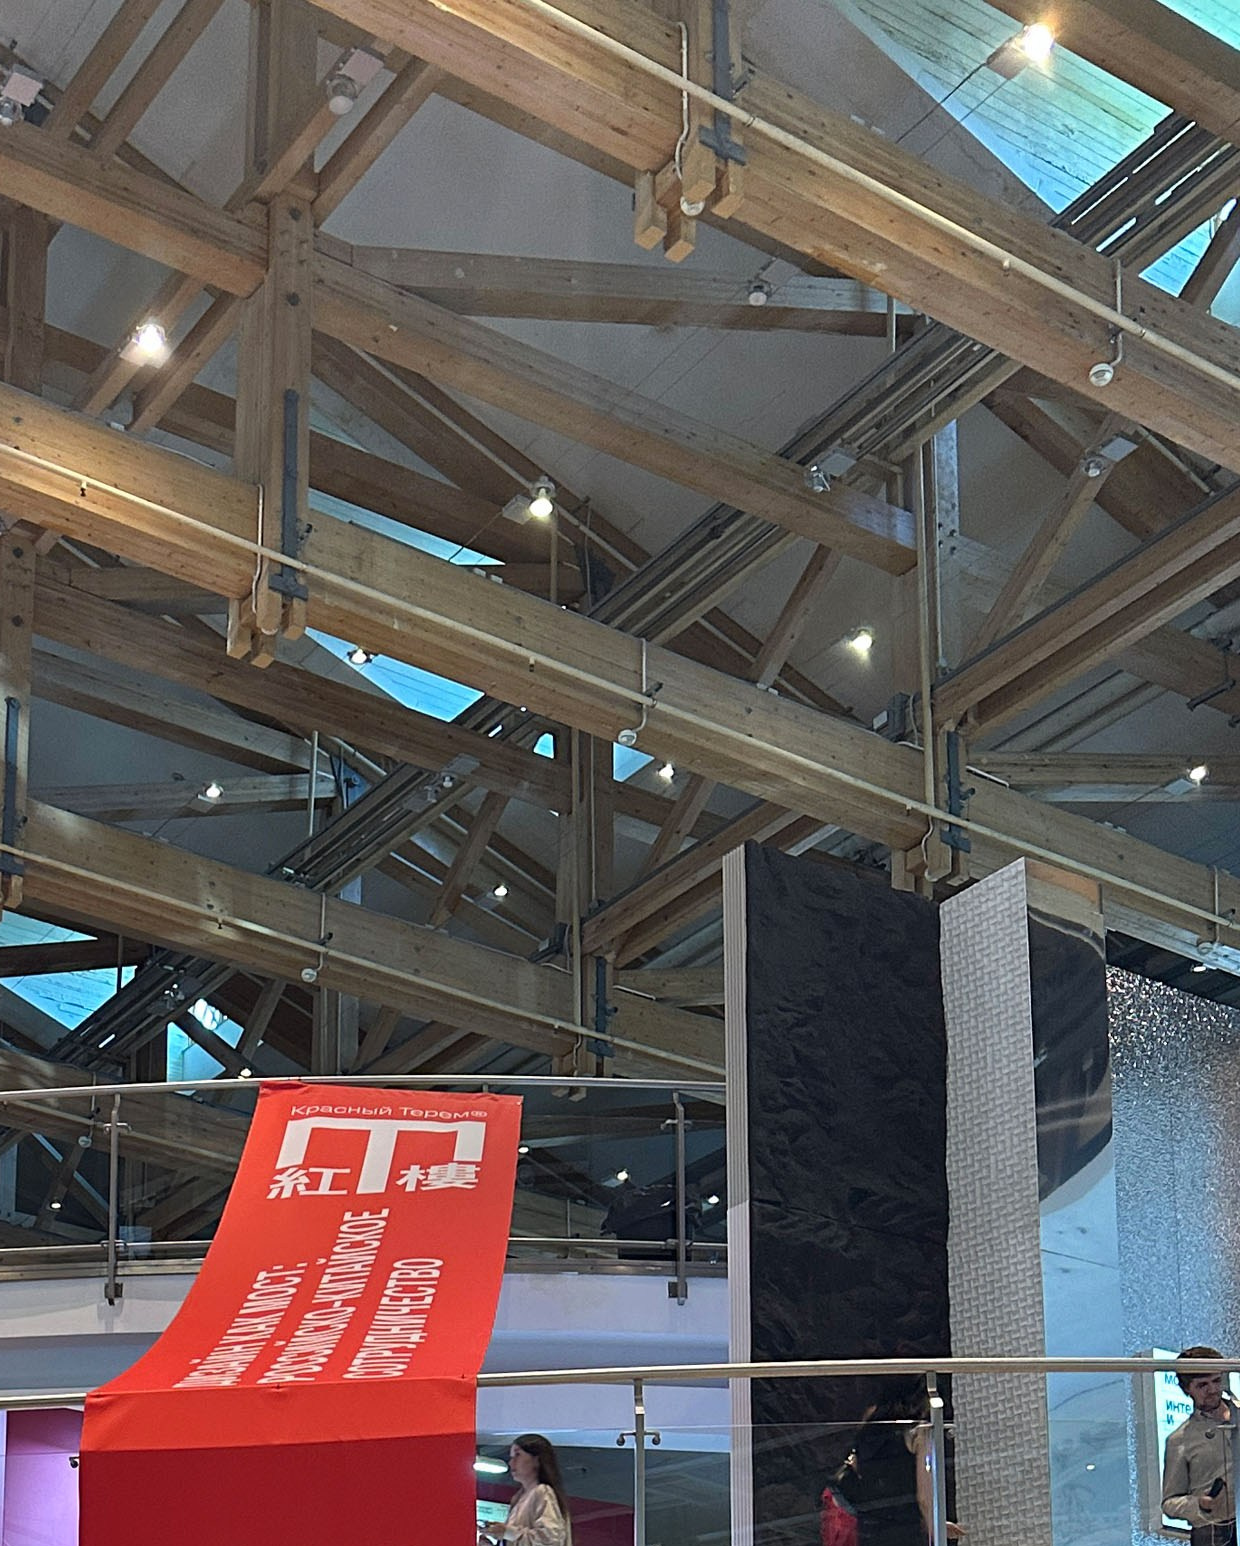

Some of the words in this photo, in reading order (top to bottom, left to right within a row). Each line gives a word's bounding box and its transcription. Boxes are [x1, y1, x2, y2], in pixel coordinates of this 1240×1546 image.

[291, 1105, 392, 1116] Красный
[238, 1262, 308, 1317] МОСТ:
[256, 1207, 390, 1385] РОССИЙСКО-КИТАЙСКОЕ
[220, 1310, 286, 1345] КАК
[341, 1257, 444, 1380] СОТРУДНИЧЕСТВО
